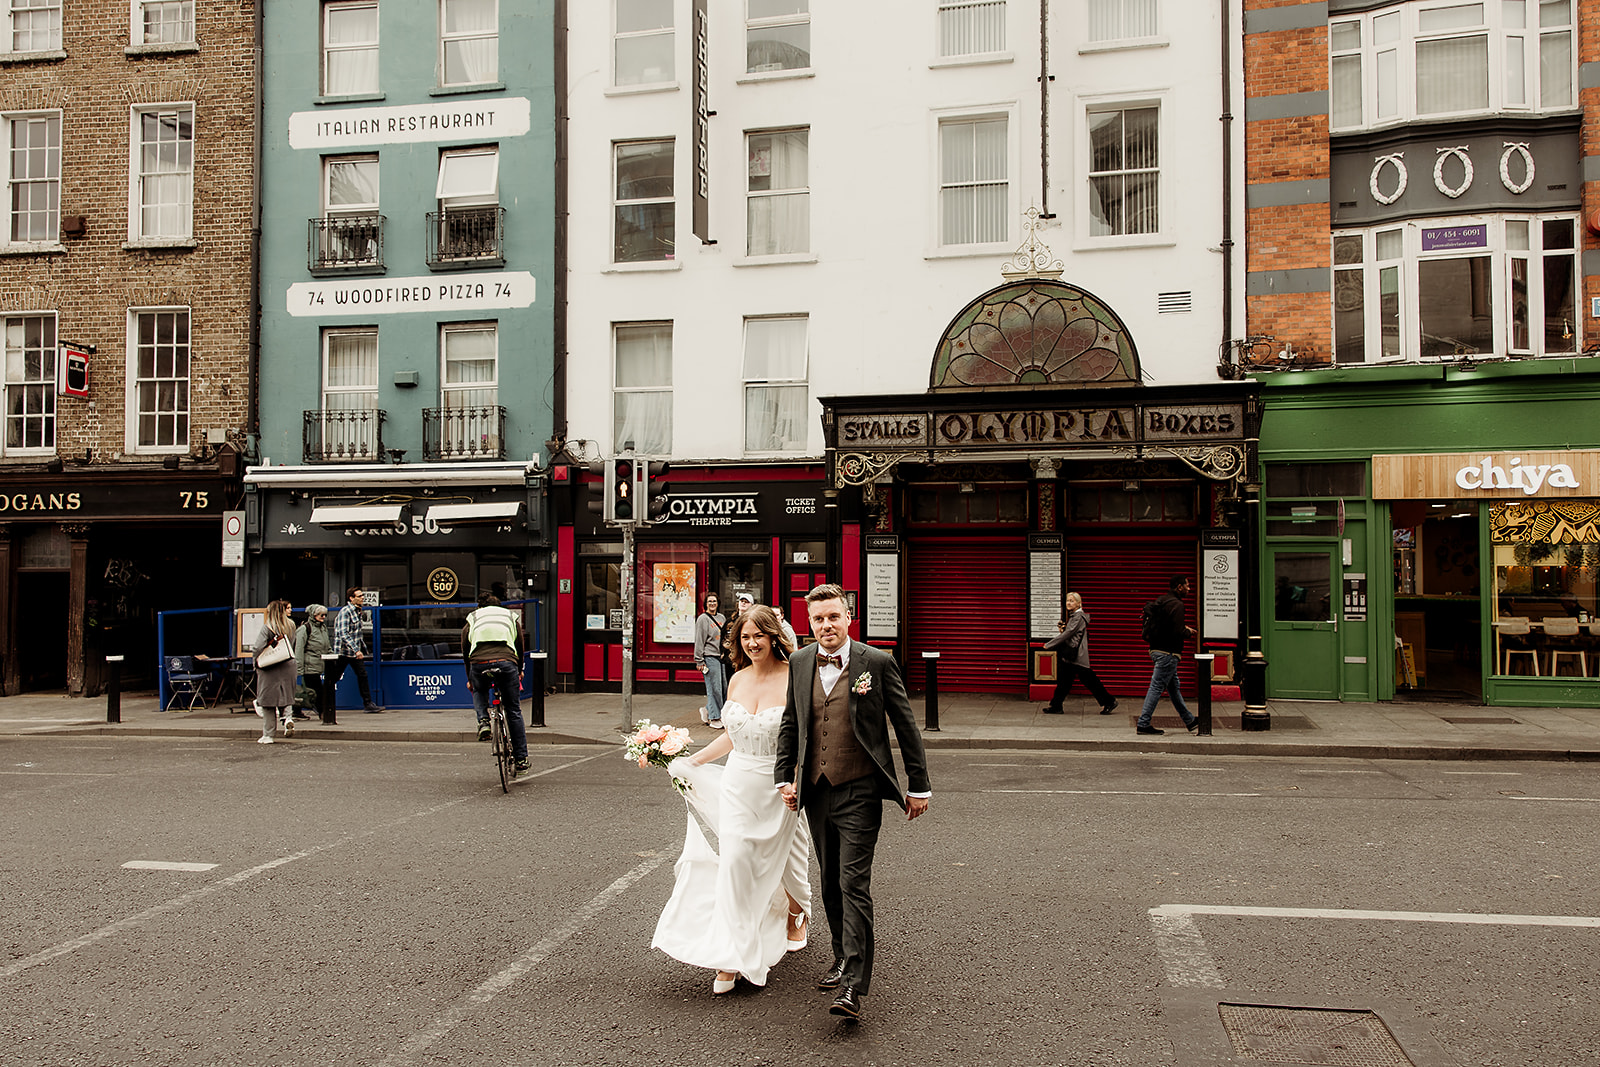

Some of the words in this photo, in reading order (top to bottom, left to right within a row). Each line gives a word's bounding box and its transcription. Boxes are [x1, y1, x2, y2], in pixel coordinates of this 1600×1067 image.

[697, 9, 708, 199] THEATRE
[317, 119, 380, 136] ITALIAN
[388, 111, 496, 132] RESTAURANT
[1443, 230, 1457, 238] 454
[1462, 228, 1480, 237] 6091
[308, 291, 325, 306] 74
[335, 286, 432, 305] WOODFIRED
[439, 283, 485, 300] PIZZA
[495, 283, 511, 298] 74
[844, 419, 921, 442] STALLS
[939, 410, 1132, 443] OLYMPIA
[1149, 411, 1236, 435] BOXES
[1455, 456, 1580, 495] chiya
[179, 491, 209, 509] 75
[670, 499, 758, 515] OLYMPIA
[785, 498, 816, 506] TICKET
[785, 506, 816, 514] OFFICE
[689, 518, 732, 526] THEATRE
[408, 674, 452, 687] PERONI
